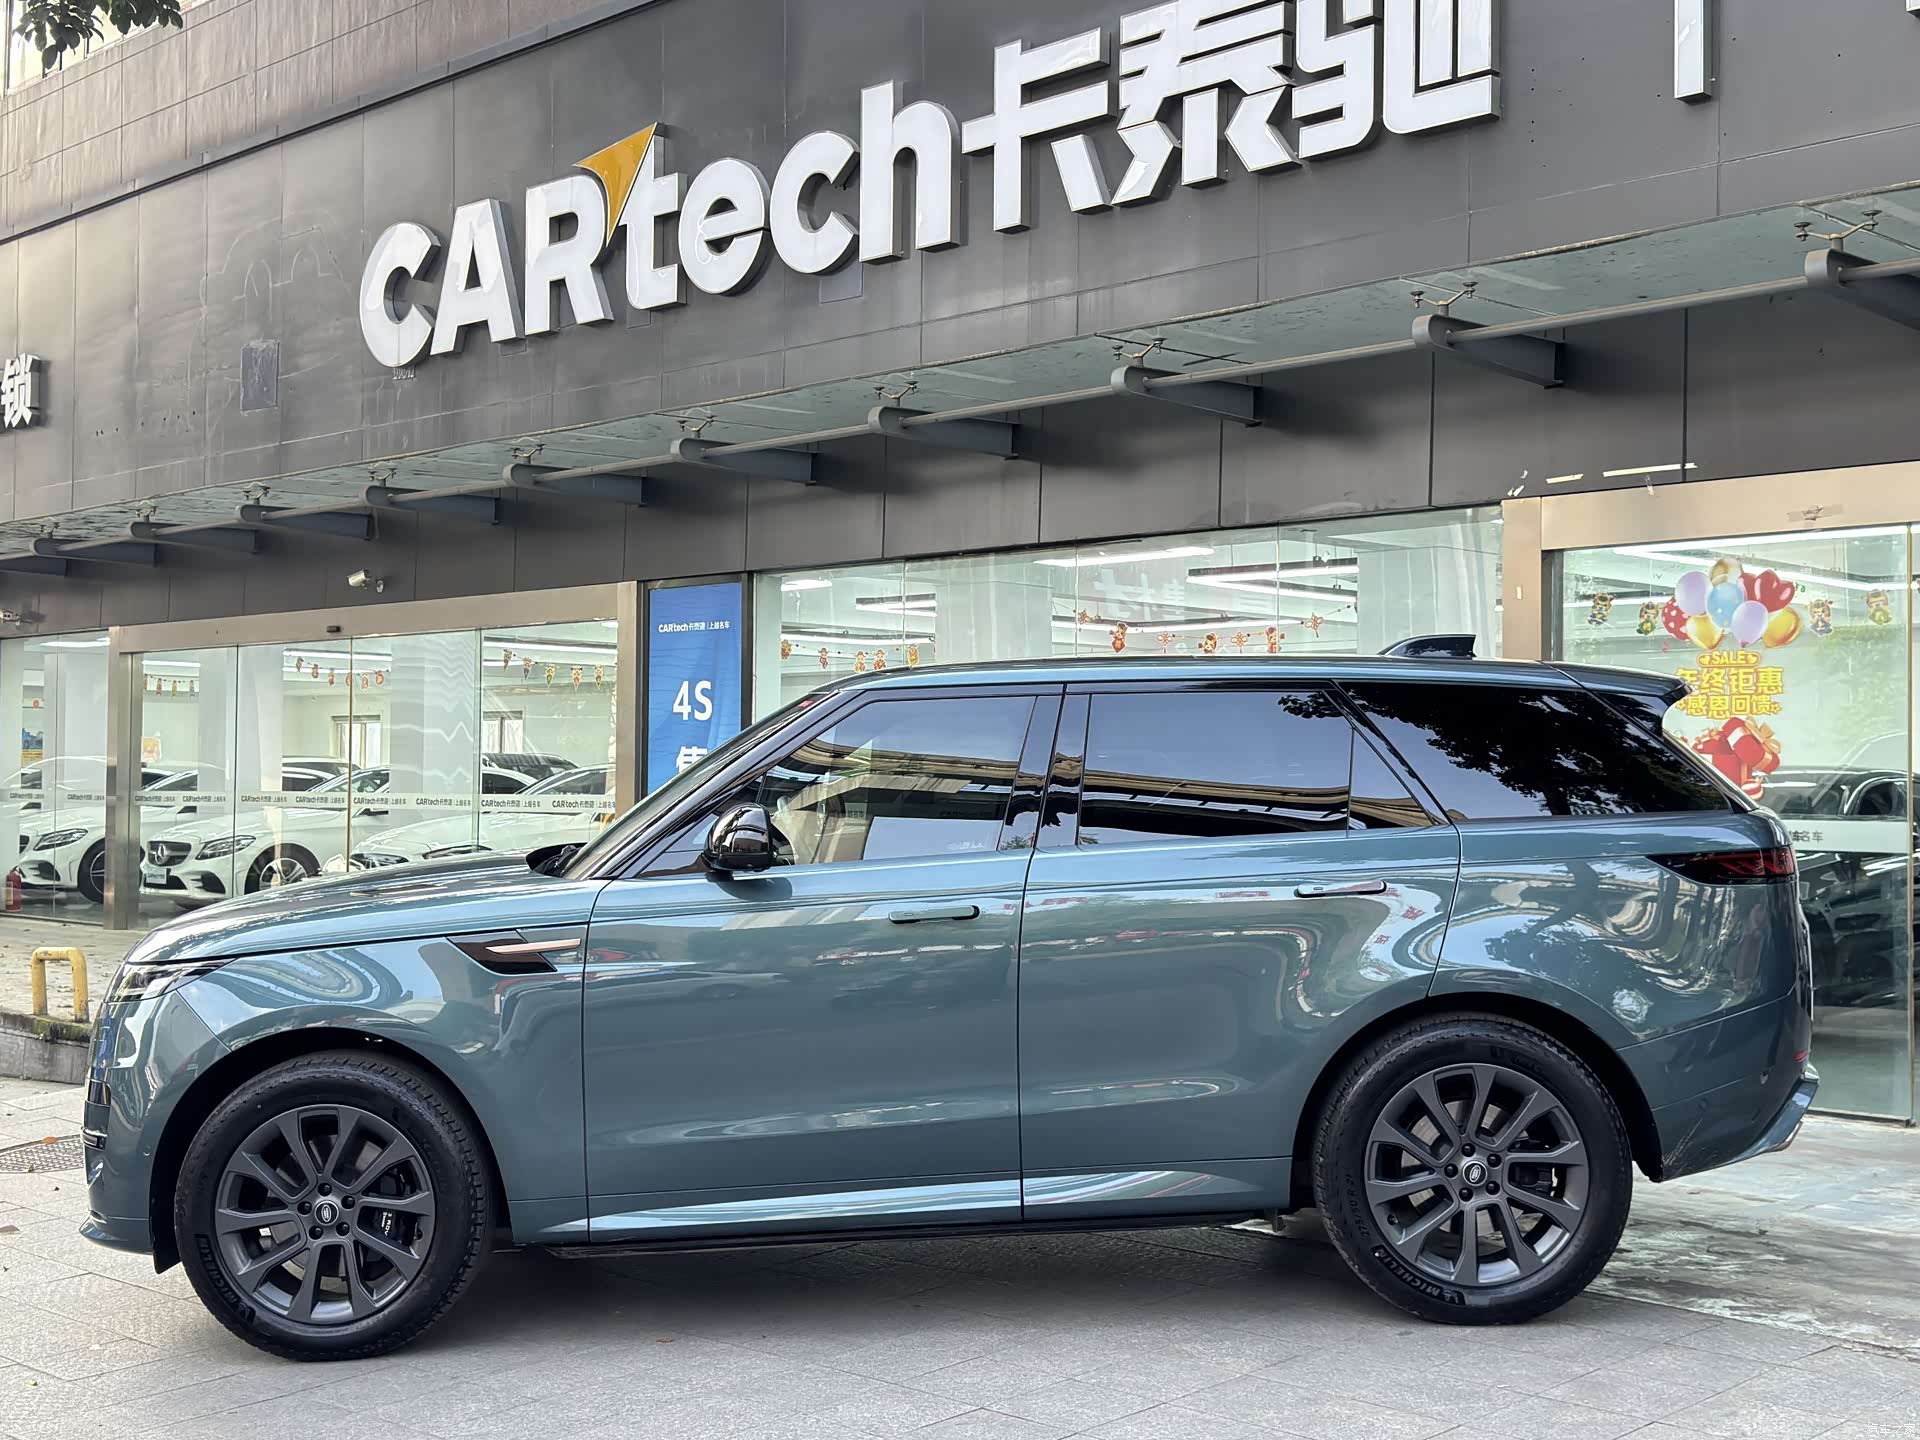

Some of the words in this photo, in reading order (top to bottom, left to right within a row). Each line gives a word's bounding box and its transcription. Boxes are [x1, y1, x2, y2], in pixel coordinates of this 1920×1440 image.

[359, 82, 956, 368] CARtech
[0, 352, 40, 429] 锁
[1712, 650, 1746, 664] SALE
[673, 680, 713, 721] 4S
[1687, 694, 1772, 719] 感恩回馈
[1375, 1246, 1442, 1298] MICHELIN
